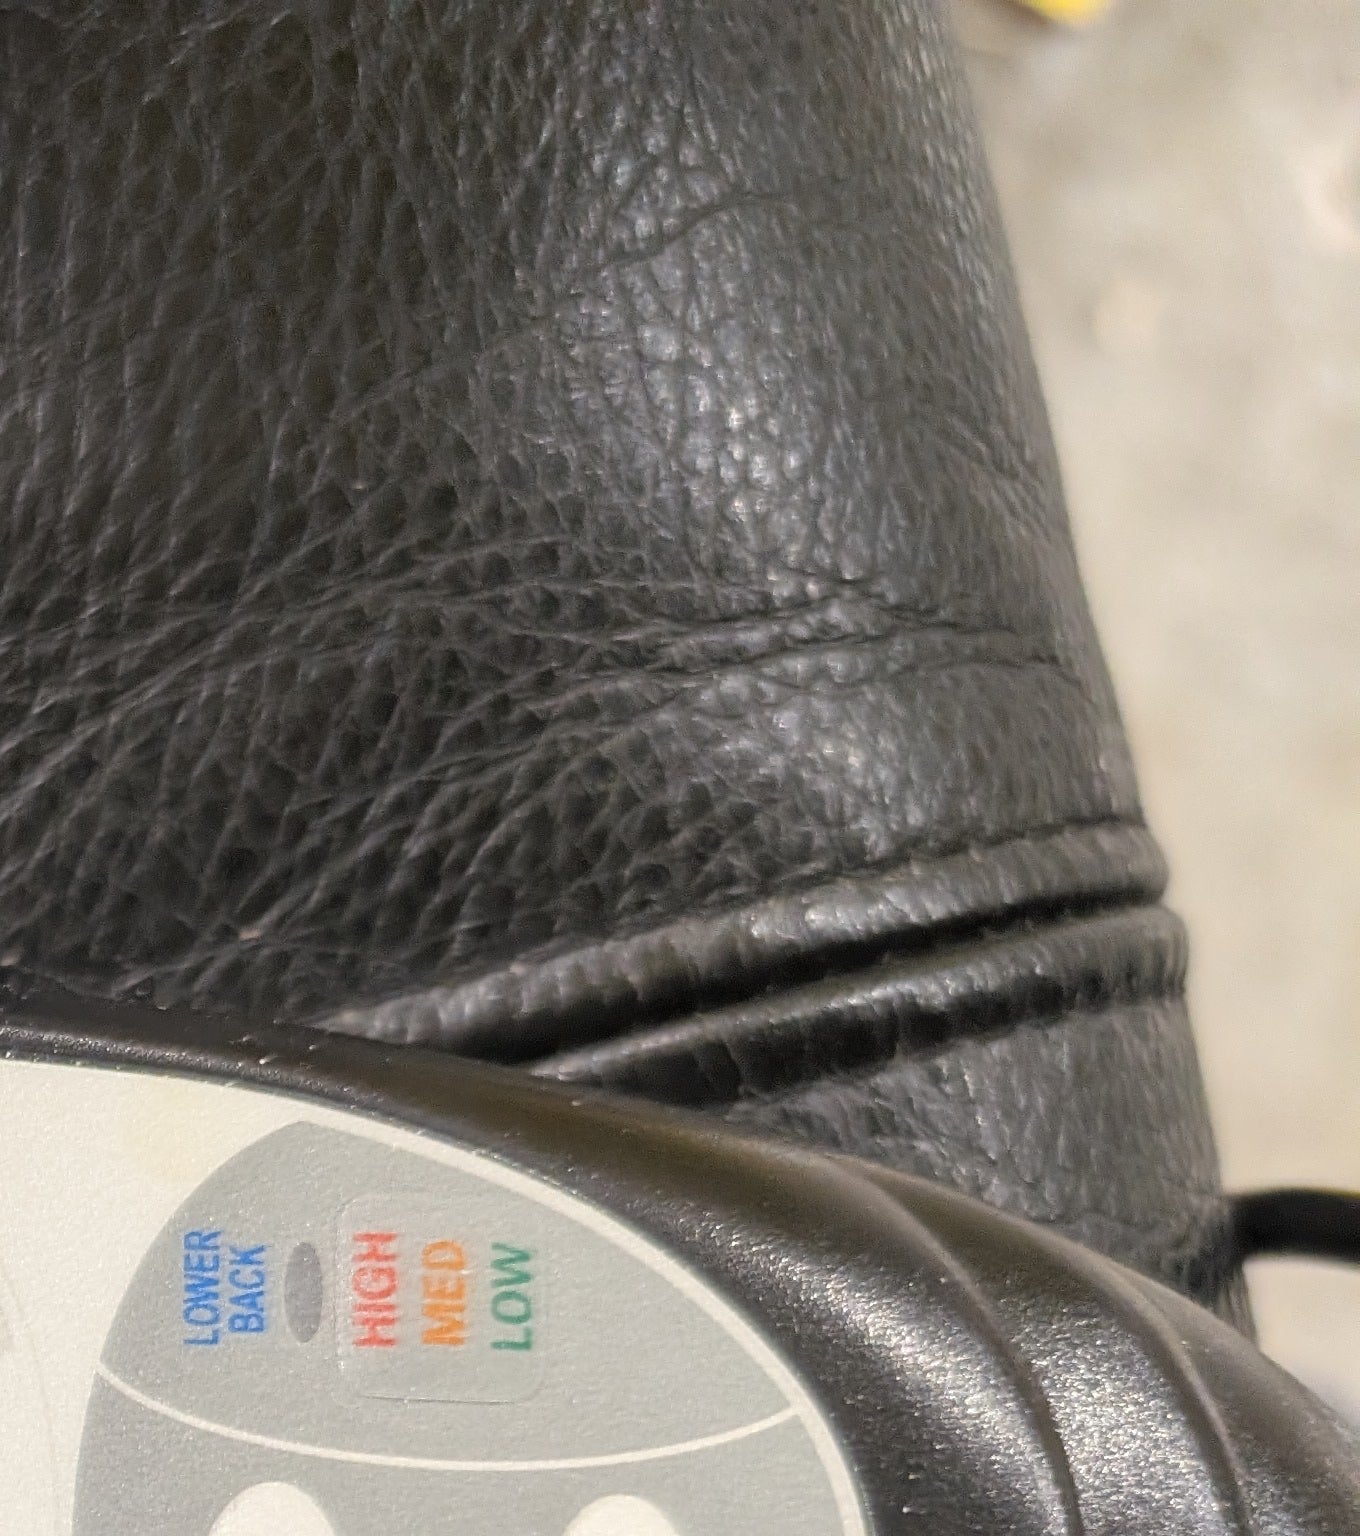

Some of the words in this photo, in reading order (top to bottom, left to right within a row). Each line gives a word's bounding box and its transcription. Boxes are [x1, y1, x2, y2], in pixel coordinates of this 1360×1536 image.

[183, 1229, 221, 1345] LOWER
[229, 1246, 265, 1334] BACK
[352, 1232, 398, 1347] HIGH
[422, 1240, 465, 1346] MED
[491, 1242, 533, 1351] LOW
